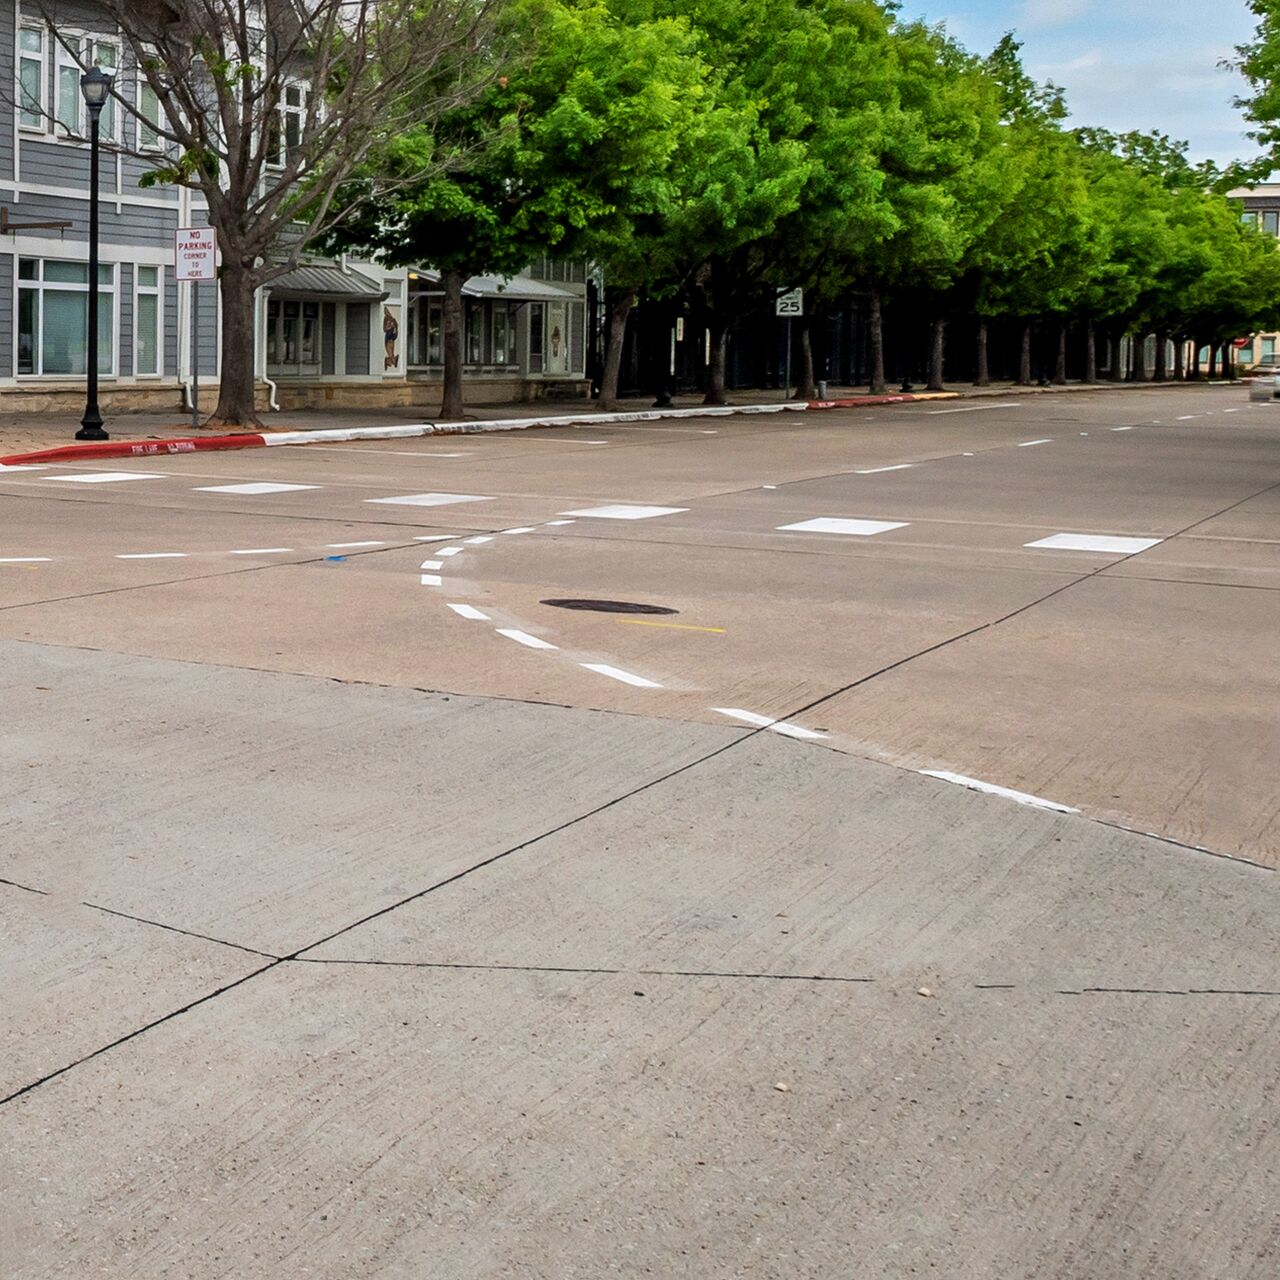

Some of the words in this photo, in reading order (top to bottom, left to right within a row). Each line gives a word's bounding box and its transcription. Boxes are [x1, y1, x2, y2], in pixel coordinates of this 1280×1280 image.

[190, 231, 200, 239] NO
[178, 242, 212, 250] PARKING
[779, 302, 800, 312] 25
